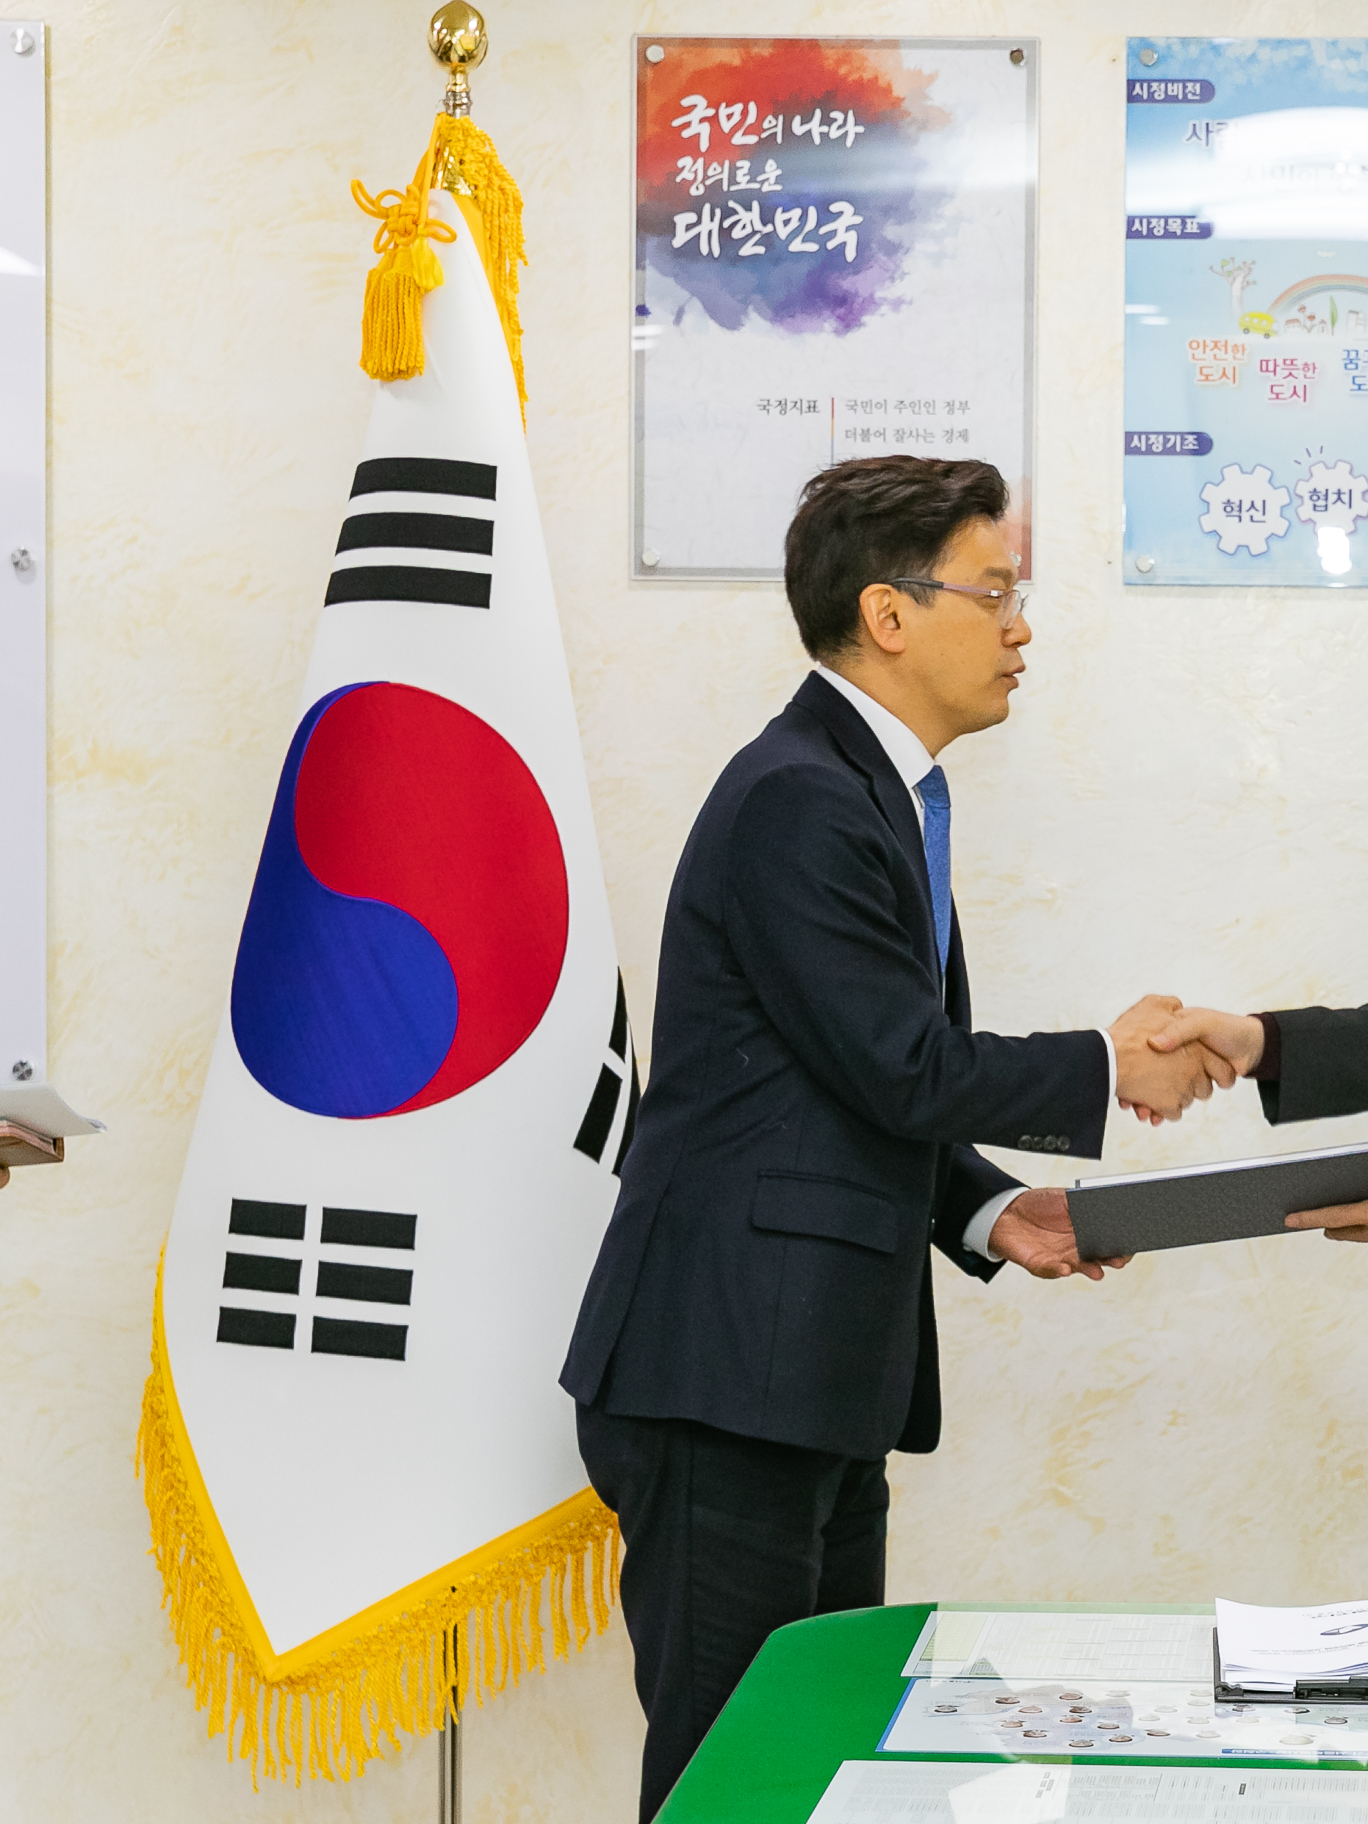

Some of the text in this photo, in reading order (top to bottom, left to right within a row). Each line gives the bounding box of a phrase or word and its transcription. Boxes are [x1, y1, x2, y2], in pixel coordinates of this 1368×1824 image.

[1132, 81, 1201, 101] 시정비전
[671, 94, 865, 152] 국민의 나라
[675, 155, 783, 196] 정의로운
[671, 200, 864, 263] 대한민국
[1131, 217, 1201, 237] 시정목표
[1188, 339, 1246, 362] 안전한
[1196, 365, 1237, 385] 도시
[1259, 358, 1318, 381] 따뜻한
[1268, 384, 1308, 403] 도시
[757, 398, 820, 416] 국정지표
[845, 399, 971, 416] 국민이 주인인 정부
[845, 427, 970, 445] 더불어 잘사는 경제
[1130, 434, 1199, 453] 시정기조
[1308, 488, 1353, 512] 협치
[1222, 498, 1267, 524] 혁신
